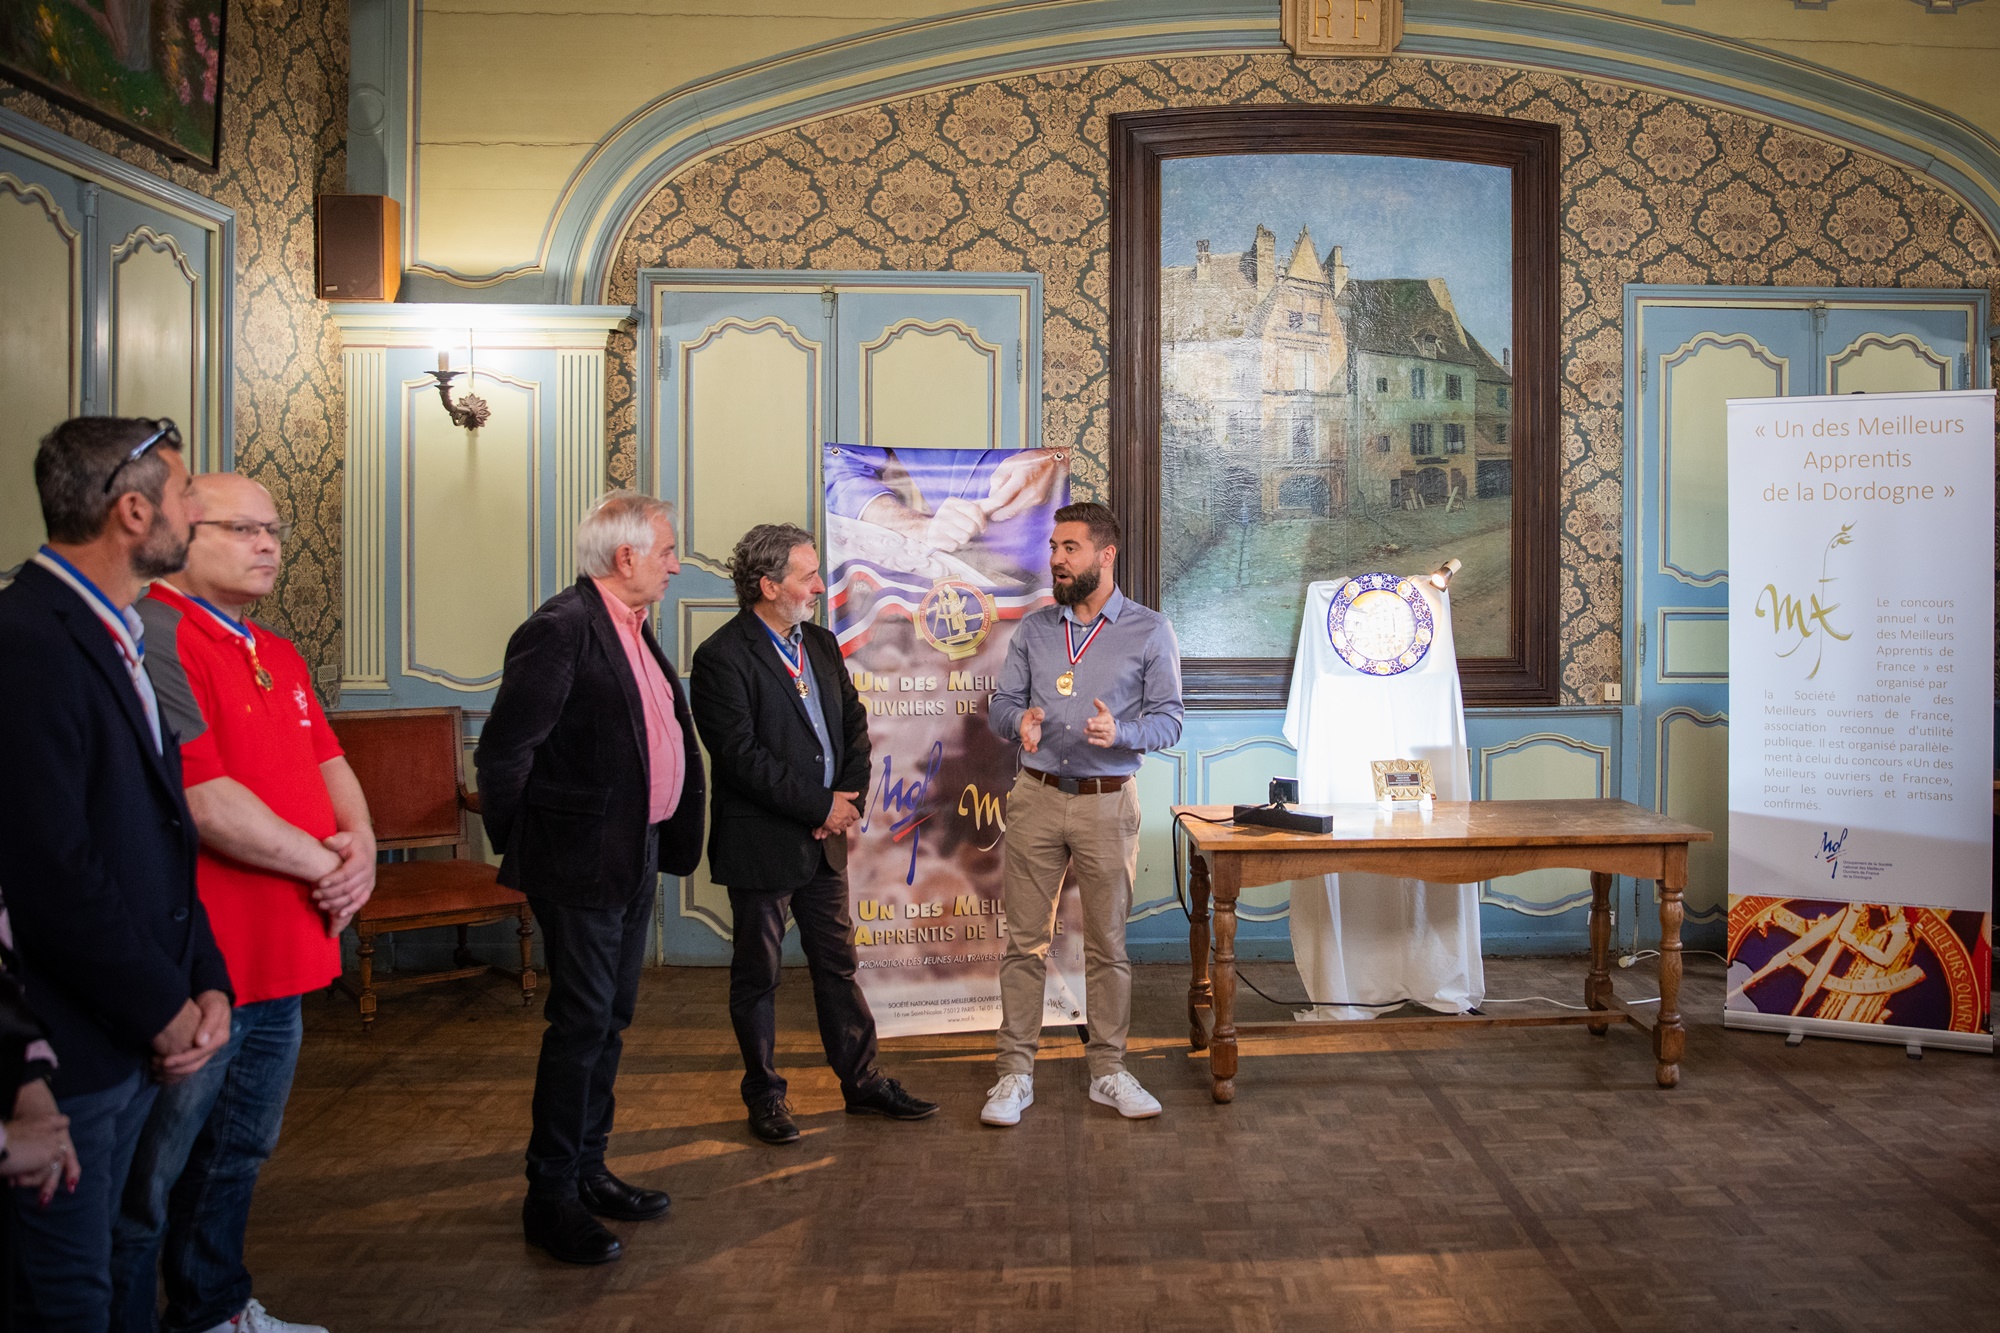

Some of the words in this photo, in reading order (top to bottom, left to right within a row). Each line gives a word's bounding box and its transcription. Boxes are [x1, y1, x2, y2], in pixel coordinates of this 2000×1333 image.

[1755, 425, 1765, 437] «
[1775, 420, 1804, 438] Un
[1812, 418, 1850, 437] des
[1858, 415, 1965, 436] Meilleurs
[1803, 449, 1912, 473] Apprentis
[1763, 482, 1789, 502] de
[1797, 482, 1814, 501] la
[1823, 481, 1934, 504] Dordogne
[1943, 485, 1955, 498] »
[1877, 598, 1890, 608] Le
[1900, 599, 1954, 608] concours
[1876, 613, 1916, 624] annuel
[1937, 614, 1954, 624] Un
[1876, 629, 1897, 640] des
[1900, 630, 1954, 641] Meilleurs
[1876, 645, 1933, 658] Apprentis
[1939, 646, 1954, 657] de
[1876, 661, 1916, 672] France
[1936, 664, 1954, 673] est
[853, 672, 890, 692] UN
[899, 676, 937, 692] DES
[947, 671, 997, 691] MEIL
[1876, 678, 1925, 690] organisé
[1929, 680, 1948, 690] par
[1764, 689, 1774, 700] la
[1794, 690, 1836, 701] Société
[1857, 693, 1911, 704] nationale
[1933, 694, 1954, 705] des
[956, 700, 977, 715] DE
[1764, 706, 1817, 717] Meilleurs
[1827, 708, 1874, 719] ouvriers
[1884, 708, 1899, 719] de
[1910, 710, 1953, 722] France,
[1764, 722, 1826, 732] association
[1840, 725, 1895, 735] reconnue
[1908, 726, 1954, 737] d'utilité
[1764, 737, 1816, 750] publique.
[1819, 738, 1825, 748] Il
[1828, 739, 1845, 749] est
[1848, 740, 1896, 752] organisé
[1899, 742, 1953, 755] parallèle-
[1764, 754, 1793, 763] ment
[1796, 753, 1802, 763] à
[1805, 754, 1831, 764] celui
[1834, 755, 1849, 765] du
[1851, 757, 1903, 767] concours
[1906, 758, 1930, 768] «Un
[1933, 759, 1954, 770] des
[1764, 767, 1816, 779] Meilleurs
[1824, 771, 1871, 781] ouvriers
[1879, 772, 1894, 783] de
[1903, 773, 1953, 786] France»,
[1764, 784, 1790, 794] pour
[1801, 784, 1816, 795] les
[1827, 787, 1874, 798] ouvriers
[1884, 788, 1896, 798] et
[1907, 790, 1953, 801] artisans
[1764, 799, 1821, 810] confirmés.
[858, 900, 895, 921] UN
[905, 902, 943, 919] DES
[953, 895, 1005, 917] MEIL
[854, 925, 956, 947] APPRENTIS
[966, 924, 986, 940] DE
[858, 957, 905, 969] PROMOTION
[907, 956, 921, 967] DES
[923, 954, 951, 965] JEUNES
[953, 954, 965, 963] AU
[967, 952, 996, 963] TRAVERS
[910, 999, 939, 1007] NATIONALE
[951, 996, 977, 1004] MEILLEURS
